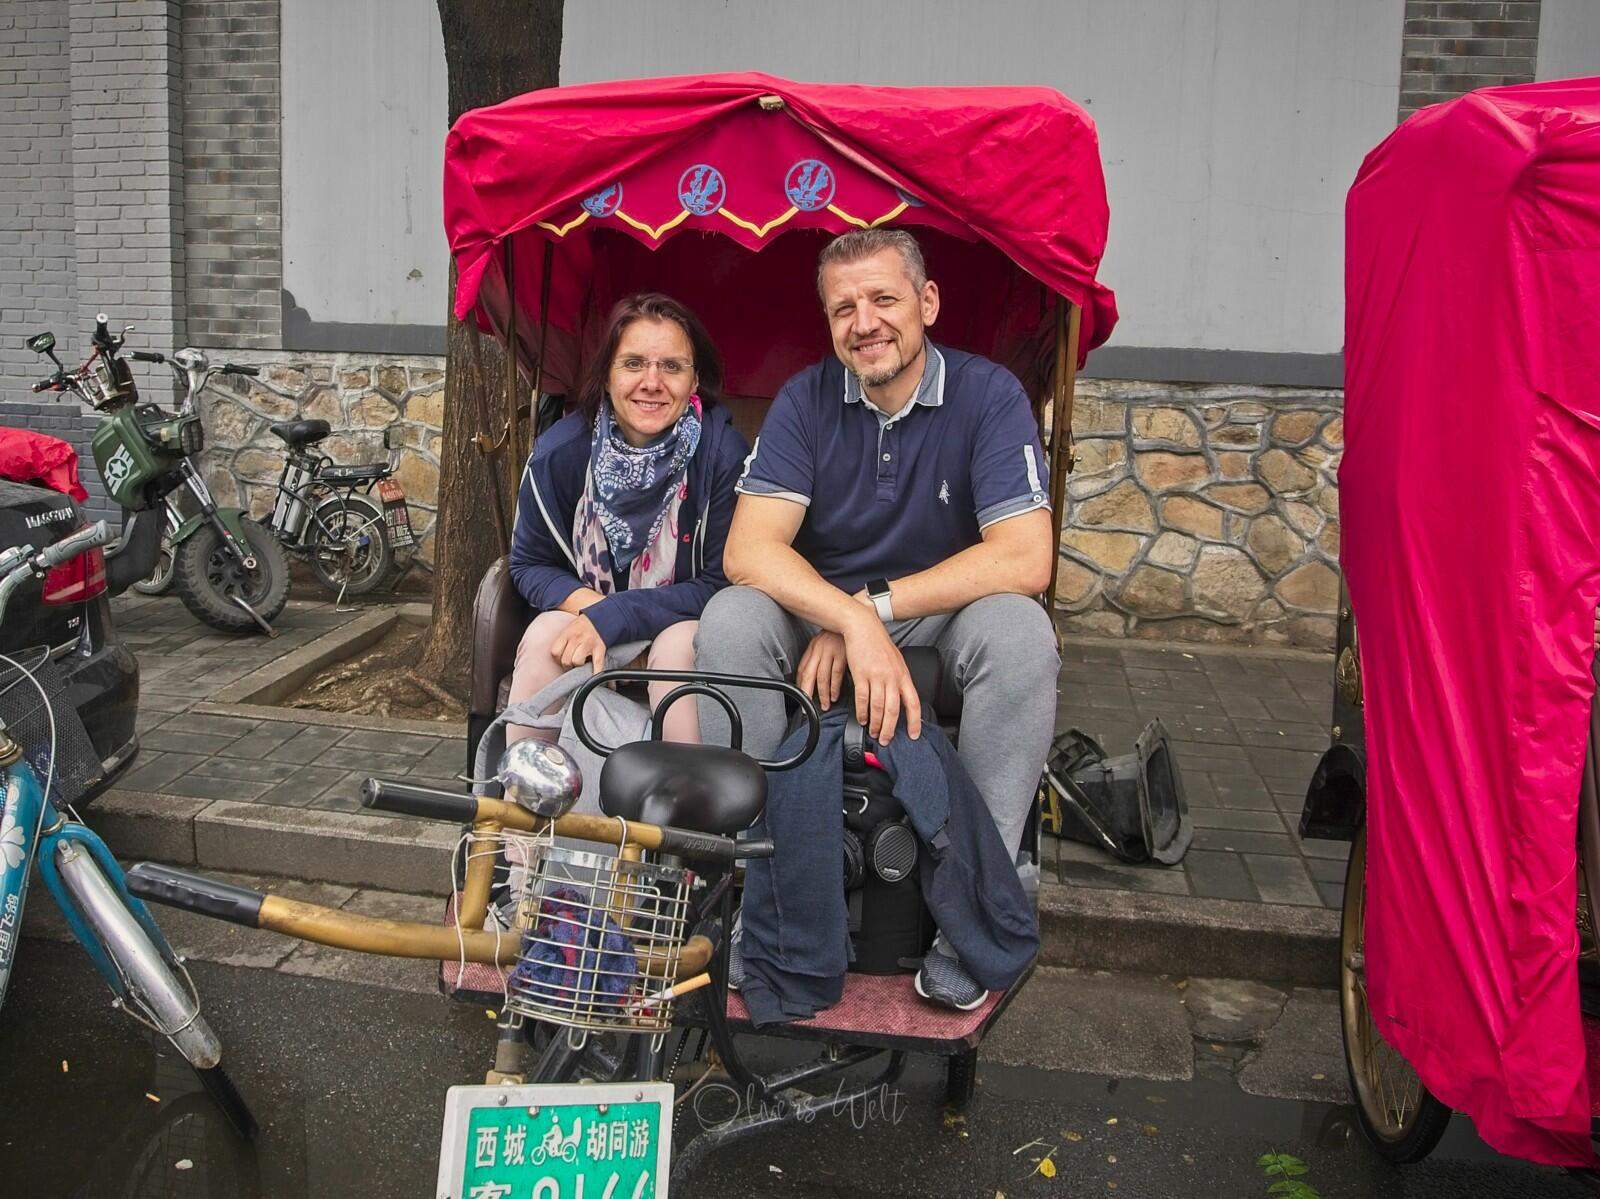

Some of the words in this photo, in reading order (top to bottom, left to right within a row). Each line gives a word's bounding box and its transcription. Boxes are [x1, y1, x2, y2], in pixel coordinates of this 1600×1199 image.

[475, 1123, 528, 1169] 西城
[586, 1117, 651, 1162] 胡同游
